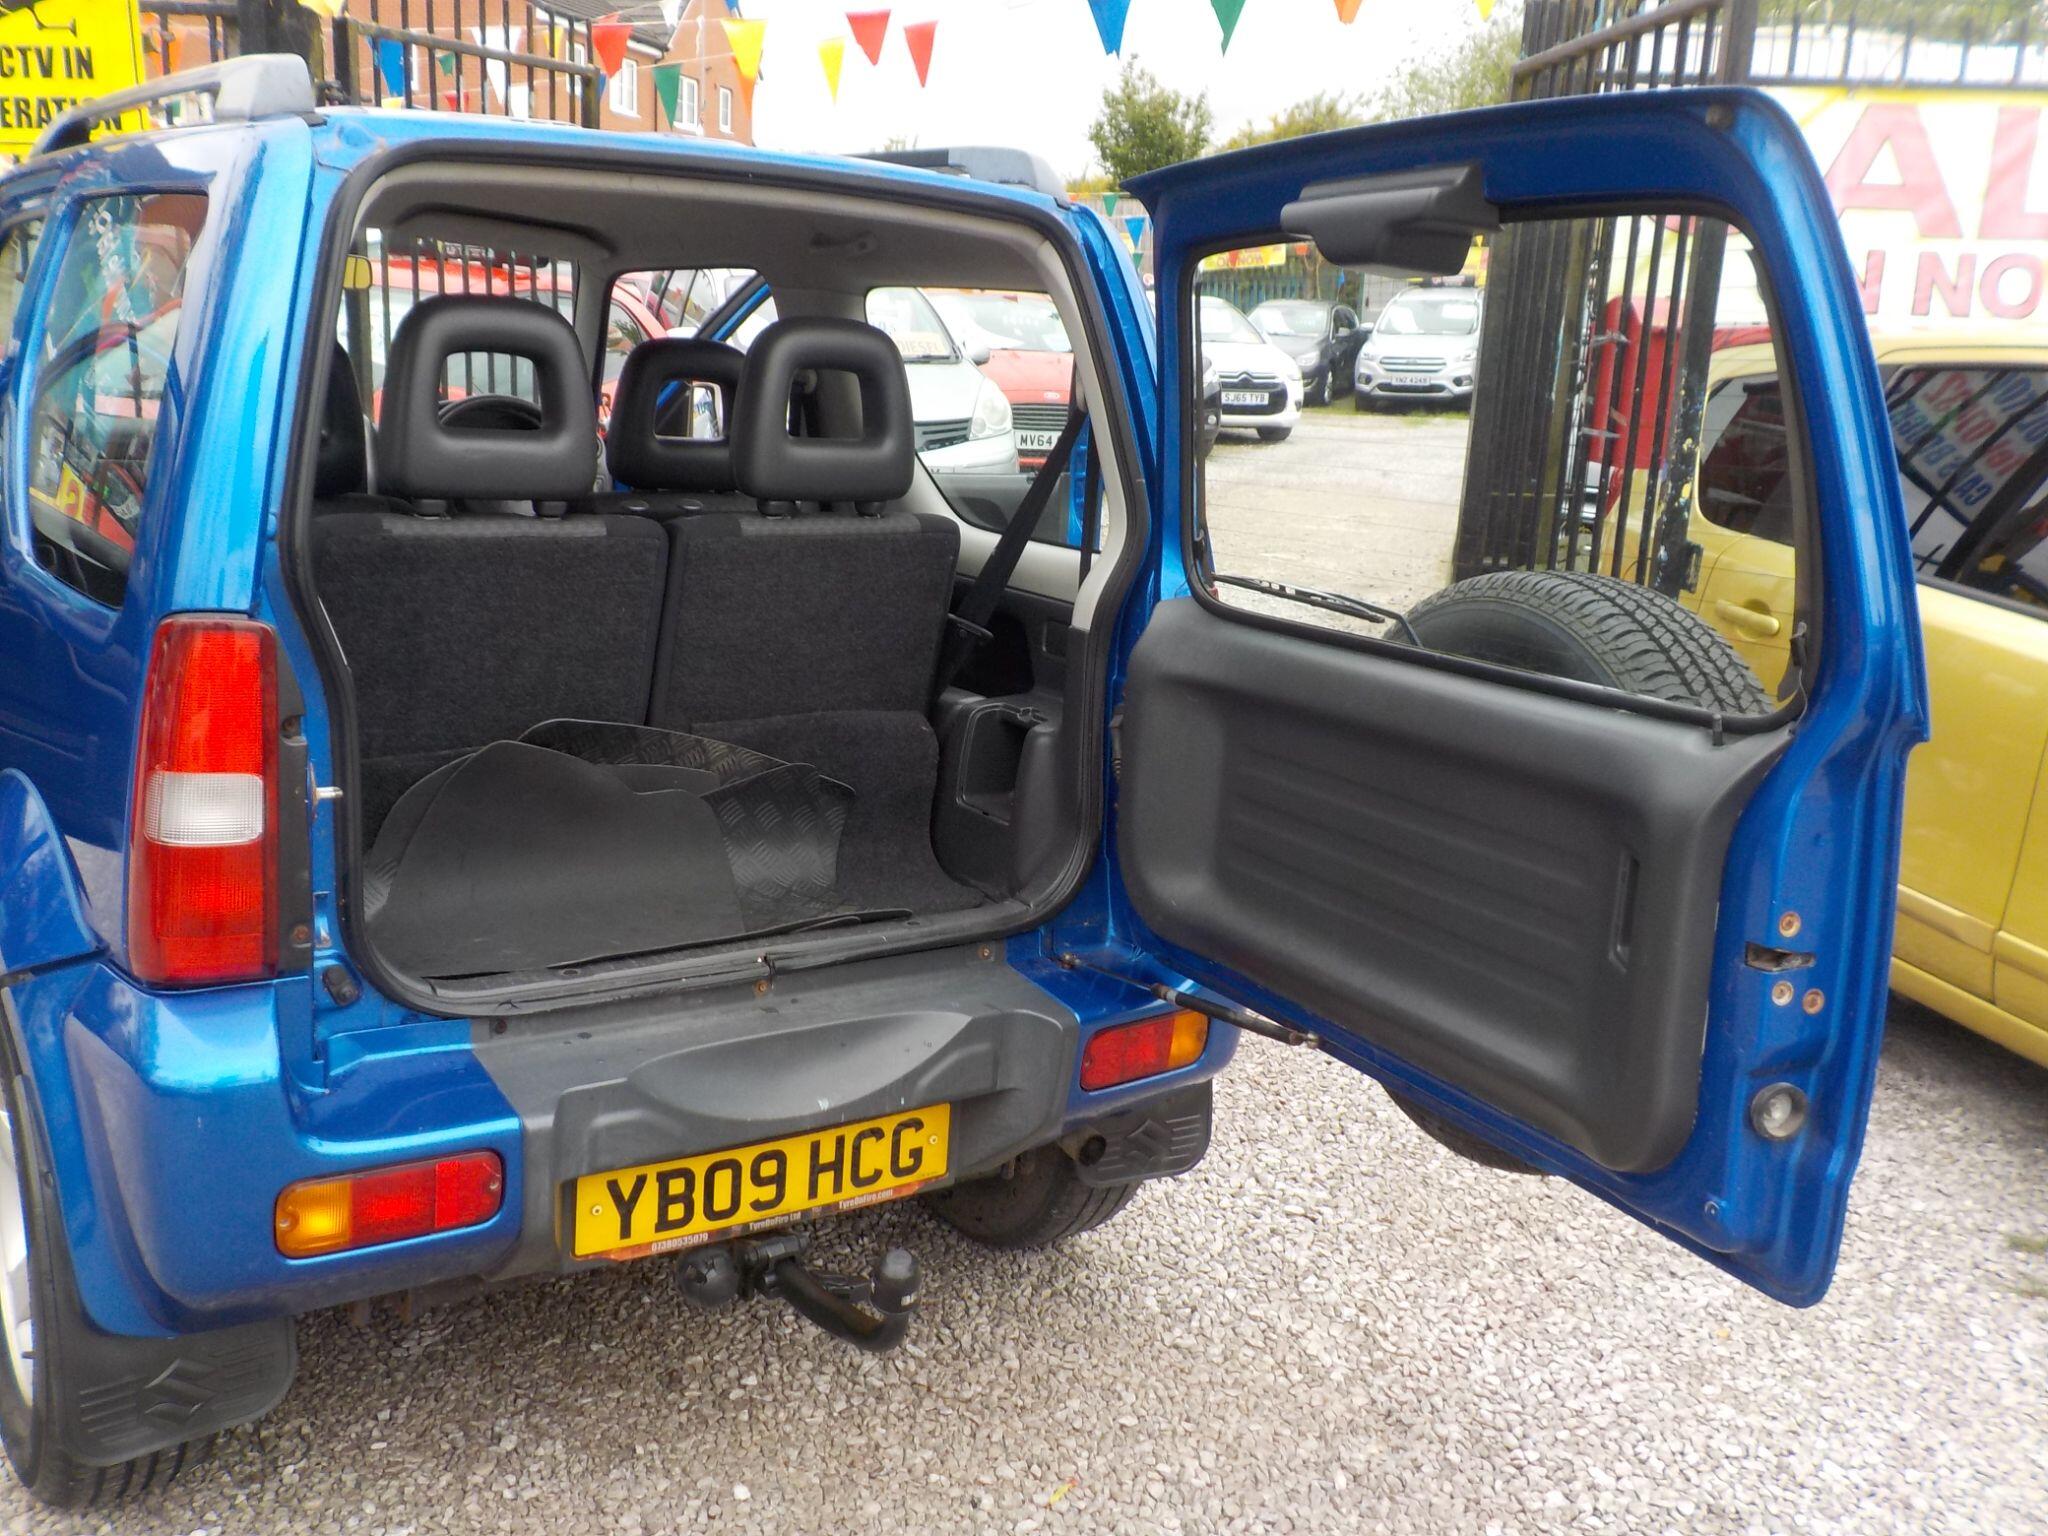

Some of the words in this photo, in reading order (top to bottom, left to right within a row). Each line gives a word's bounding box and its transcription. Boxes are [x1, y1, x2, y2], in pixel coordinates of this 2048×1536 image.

[62, 47, 94, 79] IN
[1224, 393, 1247, 402] SJ65
[1019, 434, 1053, 447] MV64
[606, 1149, 788, 1240] YB09
[807, 1116, 925, 1200] HCG
